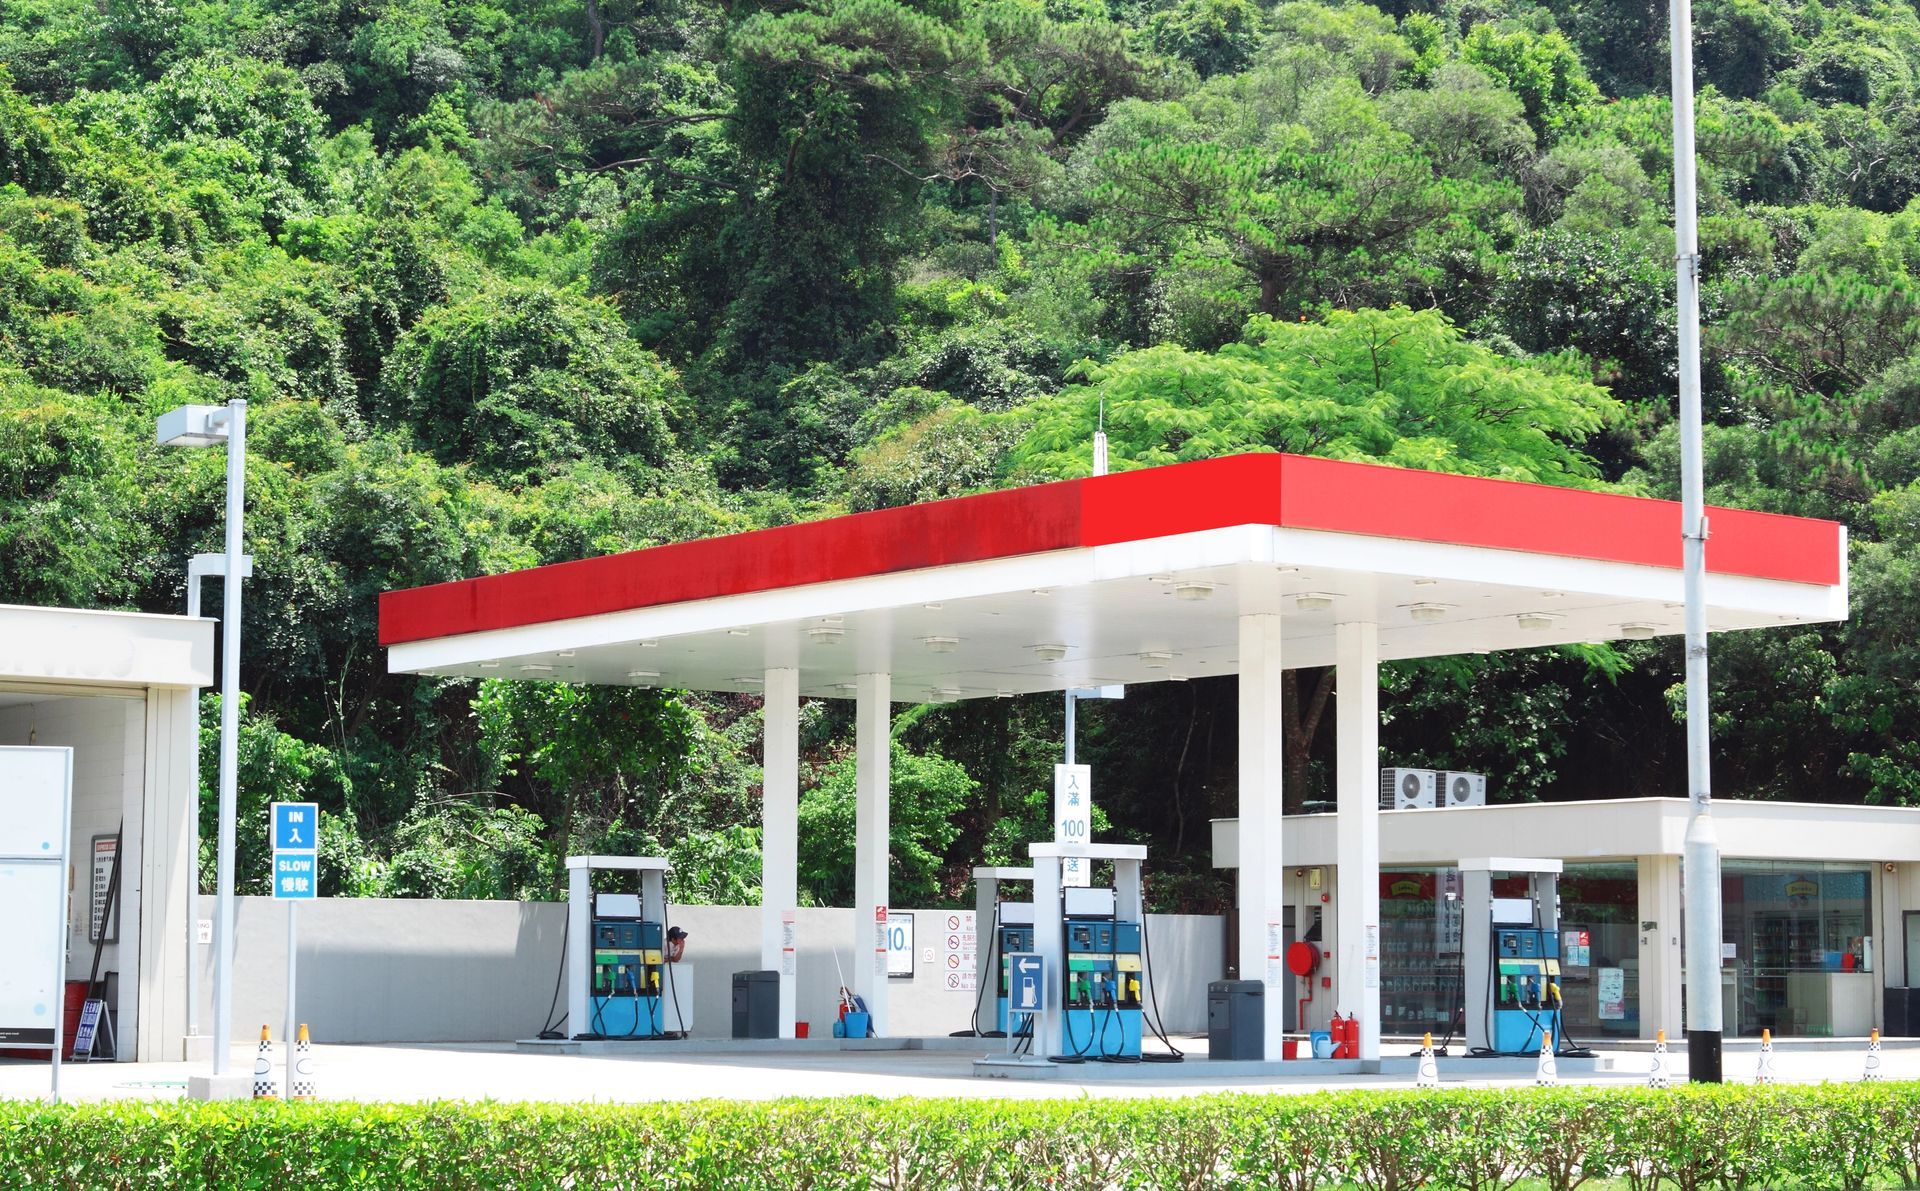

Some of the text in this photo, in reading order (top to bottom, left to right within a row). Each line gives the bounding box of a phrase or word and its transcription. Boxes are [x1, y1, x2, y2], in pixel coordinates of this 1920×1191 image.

[288, 811, 304, 823] IN
[288, 827, 303, 843] 入
[1061, 819, 1085, 837] 100
[278, 860, 312, 872] SLOW
[281, 876, 309, 892] 慢駛
